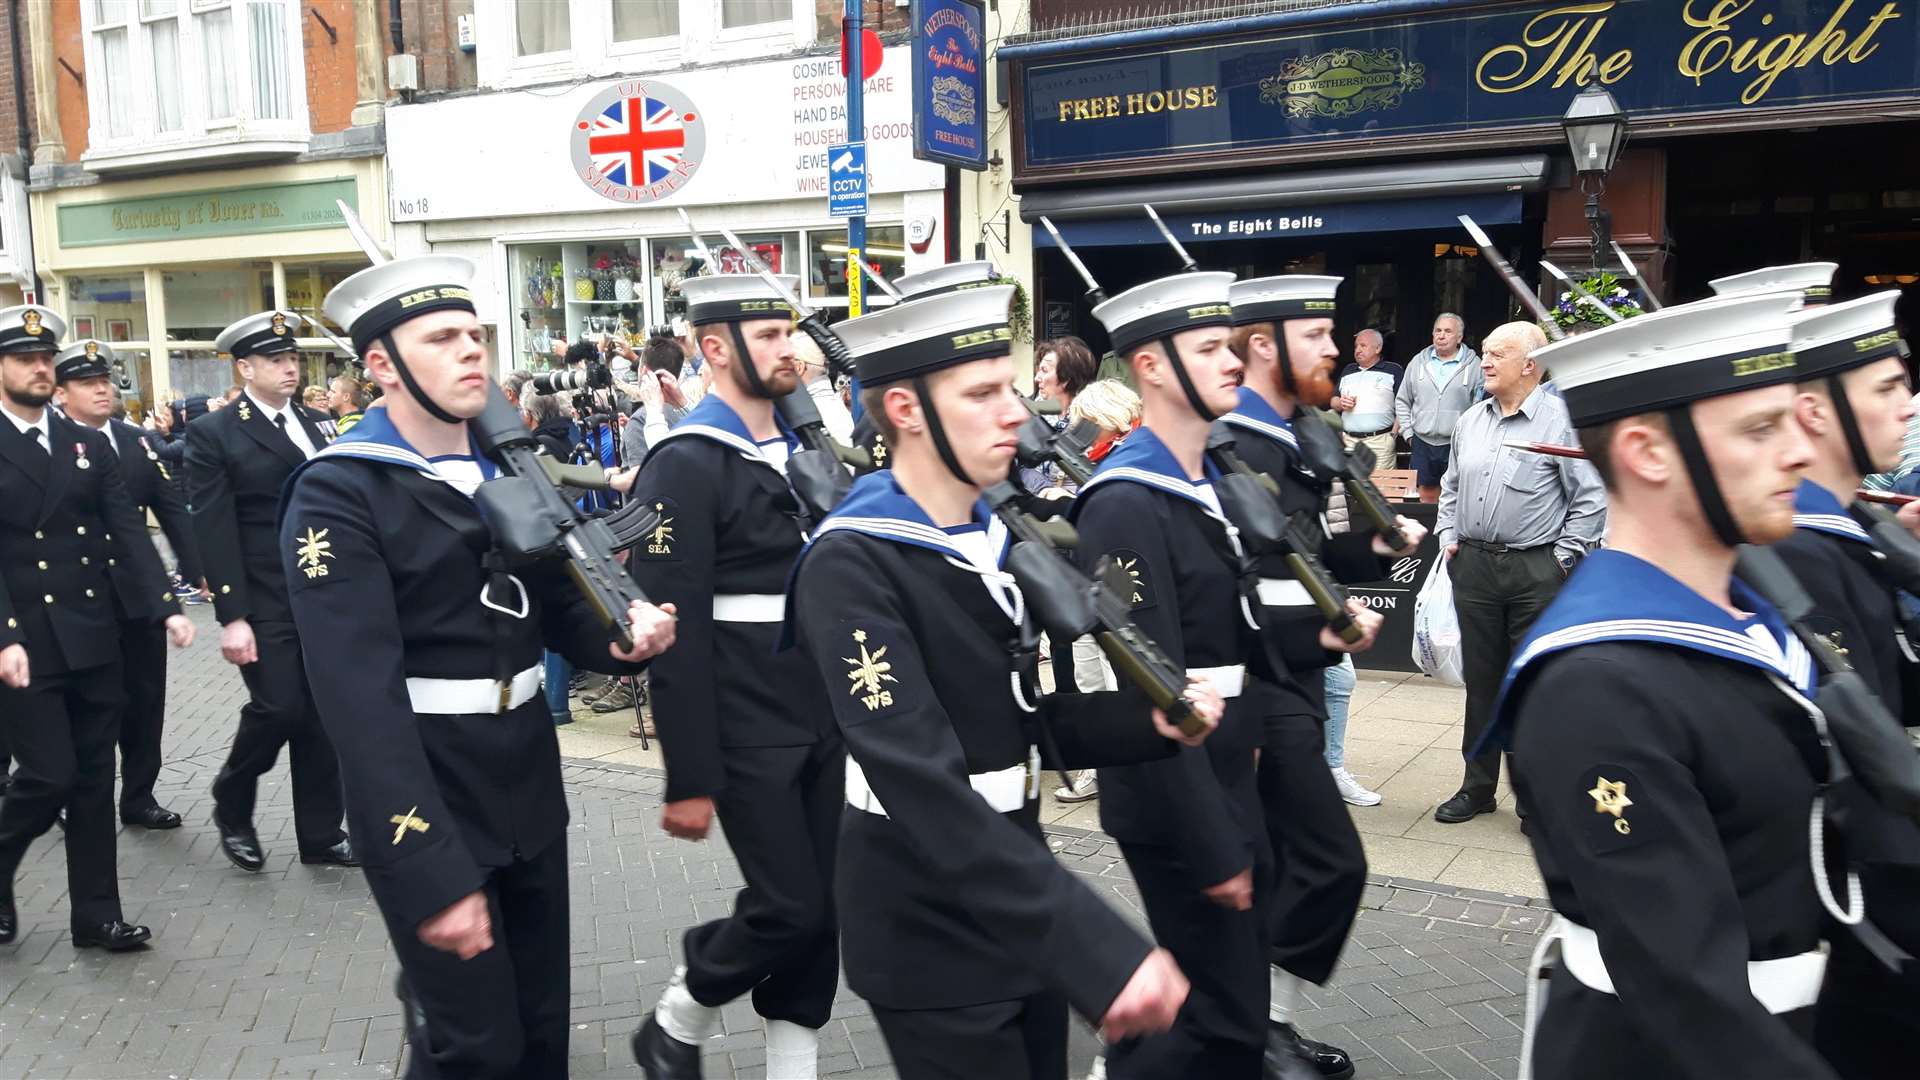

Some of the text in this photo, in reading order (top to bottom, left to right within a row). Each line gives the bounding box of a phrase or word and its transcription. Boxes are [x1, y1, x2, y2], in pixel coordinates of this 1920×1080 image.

[924, 8, 979, 50] WETHERSPOON
[928, 45, 976, 73] Eight Bells
[1475, 0, 1901, 104] The Eight
[793, 59, 842, 80] COSMET
[617, 82, 649, 97] UK
[1058, 95, 1121, 122] FREE
[1127, 85, 1217, 115] HOUSE
[794, 105, 847, 124] HAND BA
[935, 129, 977, 149] FREE HOUSE
[582, 160, 696, 201] SHOPPER
[833, 179, 862, 191] CCTV
[400, 197, 429, 215] No 18
[837, 191, 866, 202] operation
[1191, 216, 1323, 235] The Eight Bells
[648, 544, 671, 554] SEA
[303, 563, 329, 579] WS
[860, 690, 893, 711] WS
